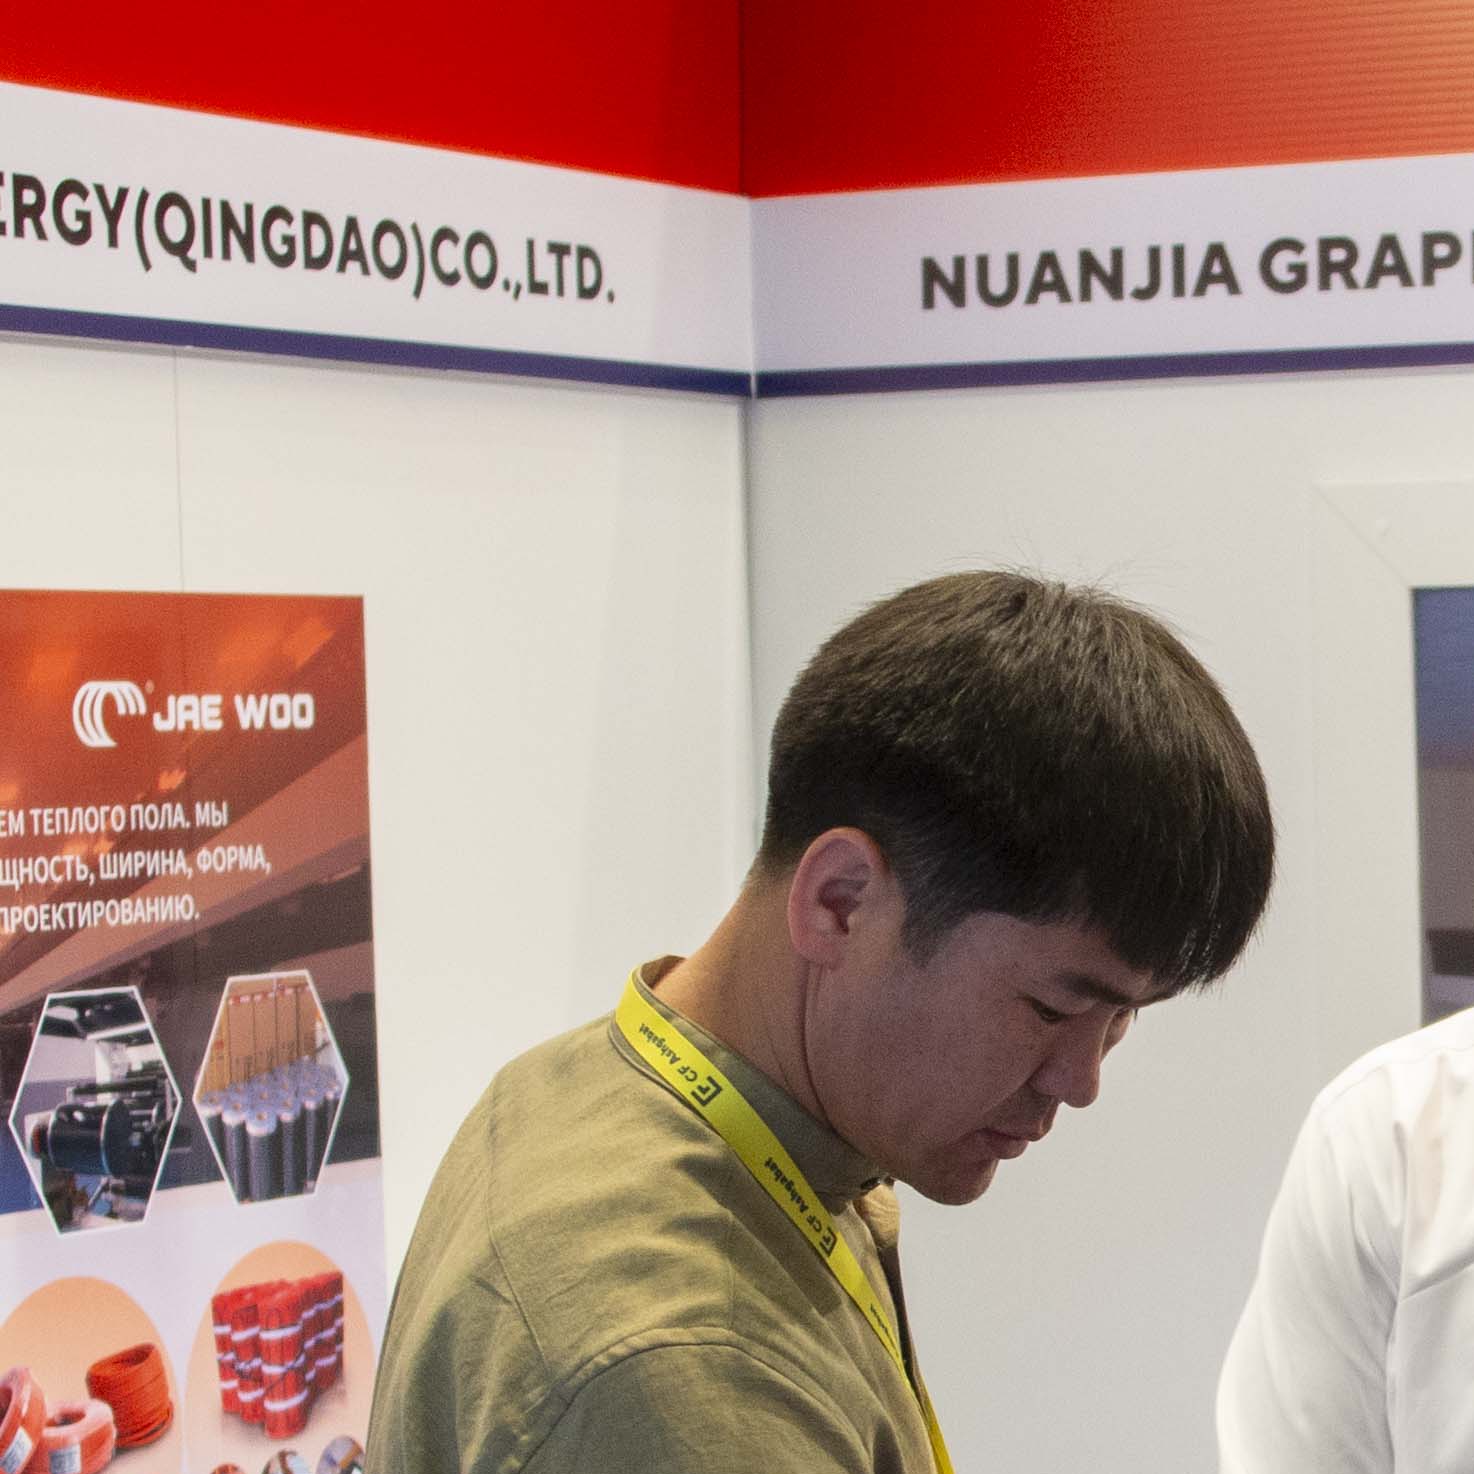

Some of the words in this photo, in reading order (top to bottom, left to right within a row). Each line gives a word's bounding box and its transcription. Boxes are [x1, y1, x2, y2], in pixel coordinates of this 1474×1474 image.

[0, 170, 616, 303] RGY(QINGDAO)CO.,LTD.
[920, 241, 1242, 311] NUANJIA
[153, 693, 223, 732] JAE
[234, 693, 315, 730] WOO
[29, 803, 127, 837] ТЕПЛОГО
[130, 802, 191, 831] ПОЛА.
[195, 801, 229, 828] МЫ
[100, 848, 194, 880] ШИРИНА,
[197, 844, 272, 875] ФОРМА,
[677, 1065, 699, 1083] CF
